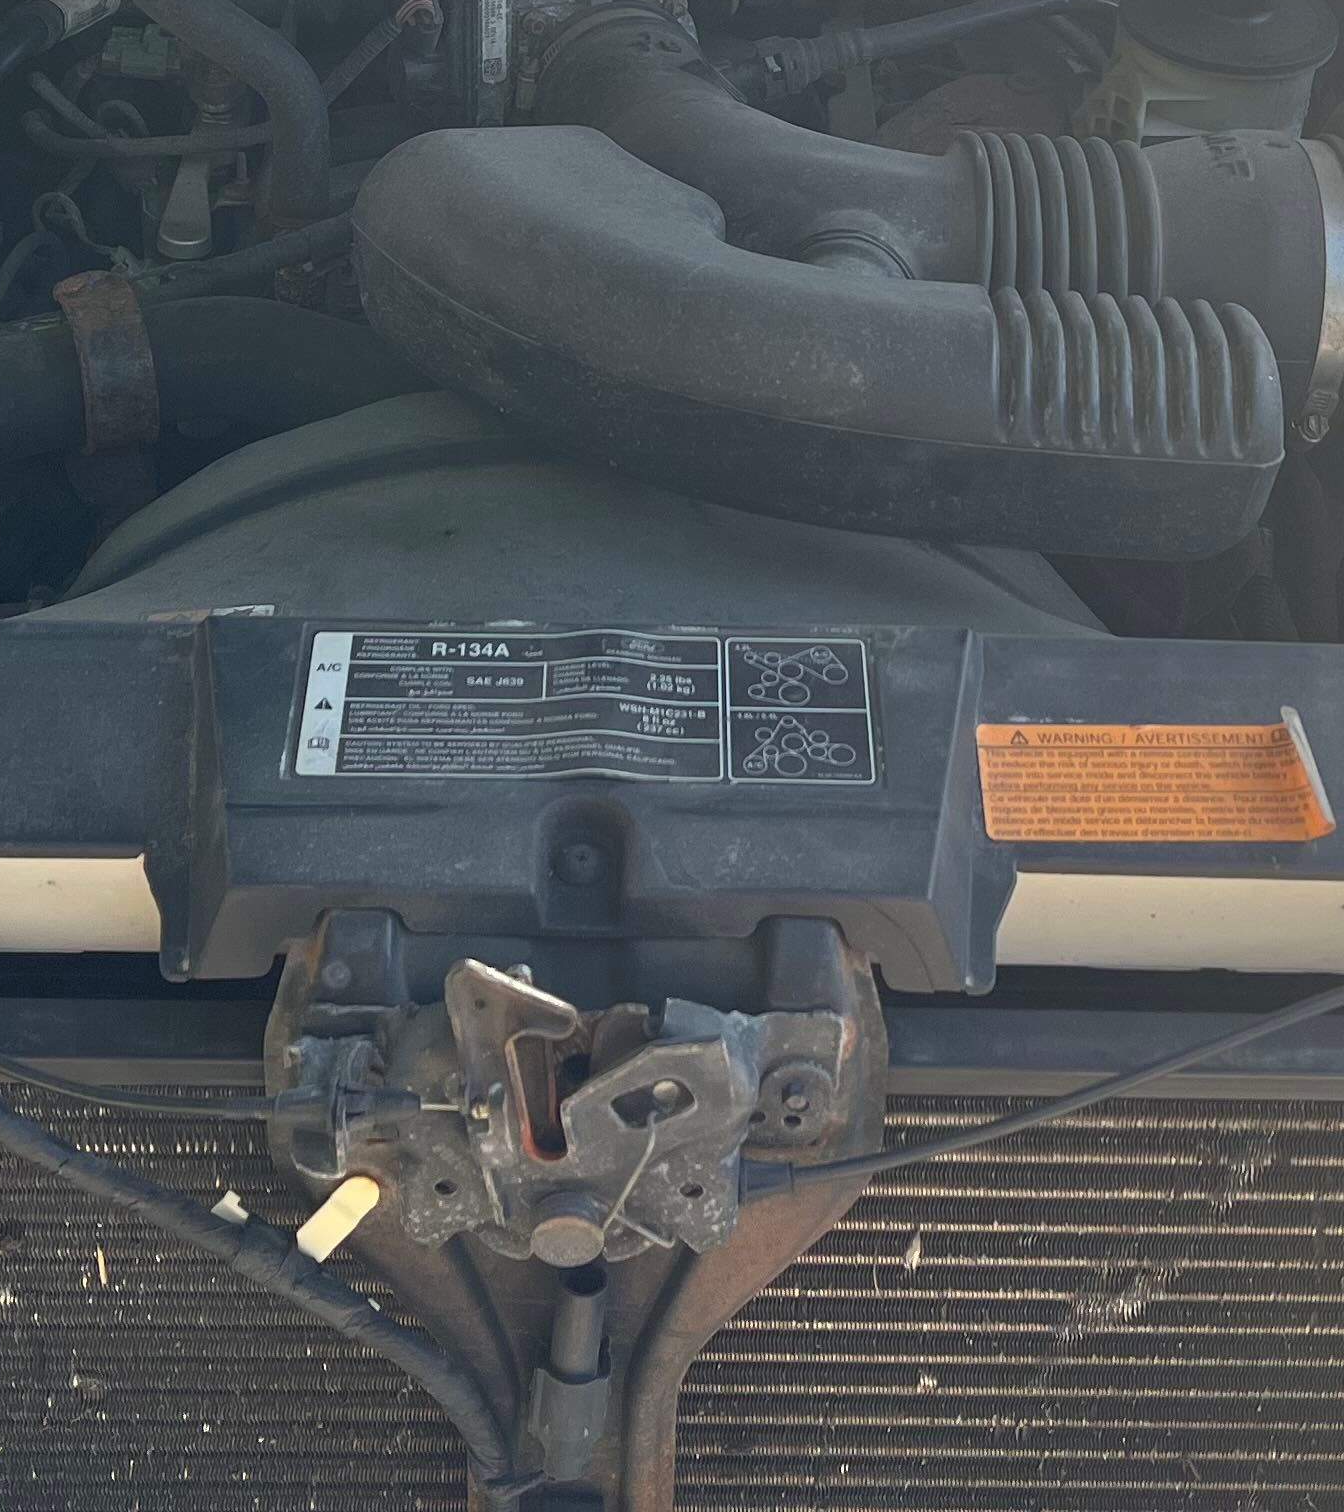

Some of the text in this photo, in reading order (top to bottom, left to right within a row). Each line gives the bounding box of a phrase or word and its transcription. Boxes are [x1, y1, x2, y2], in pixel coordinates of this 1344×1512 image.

[431, 641, 511, 657] R-134A
[316, 662, 343, 672] A/C
[466, 676, 493, 687] SAE
[1036, 732, 1113, 744] WARNING
[1135, 732, 1265, 746] AVERTISSEMENT
